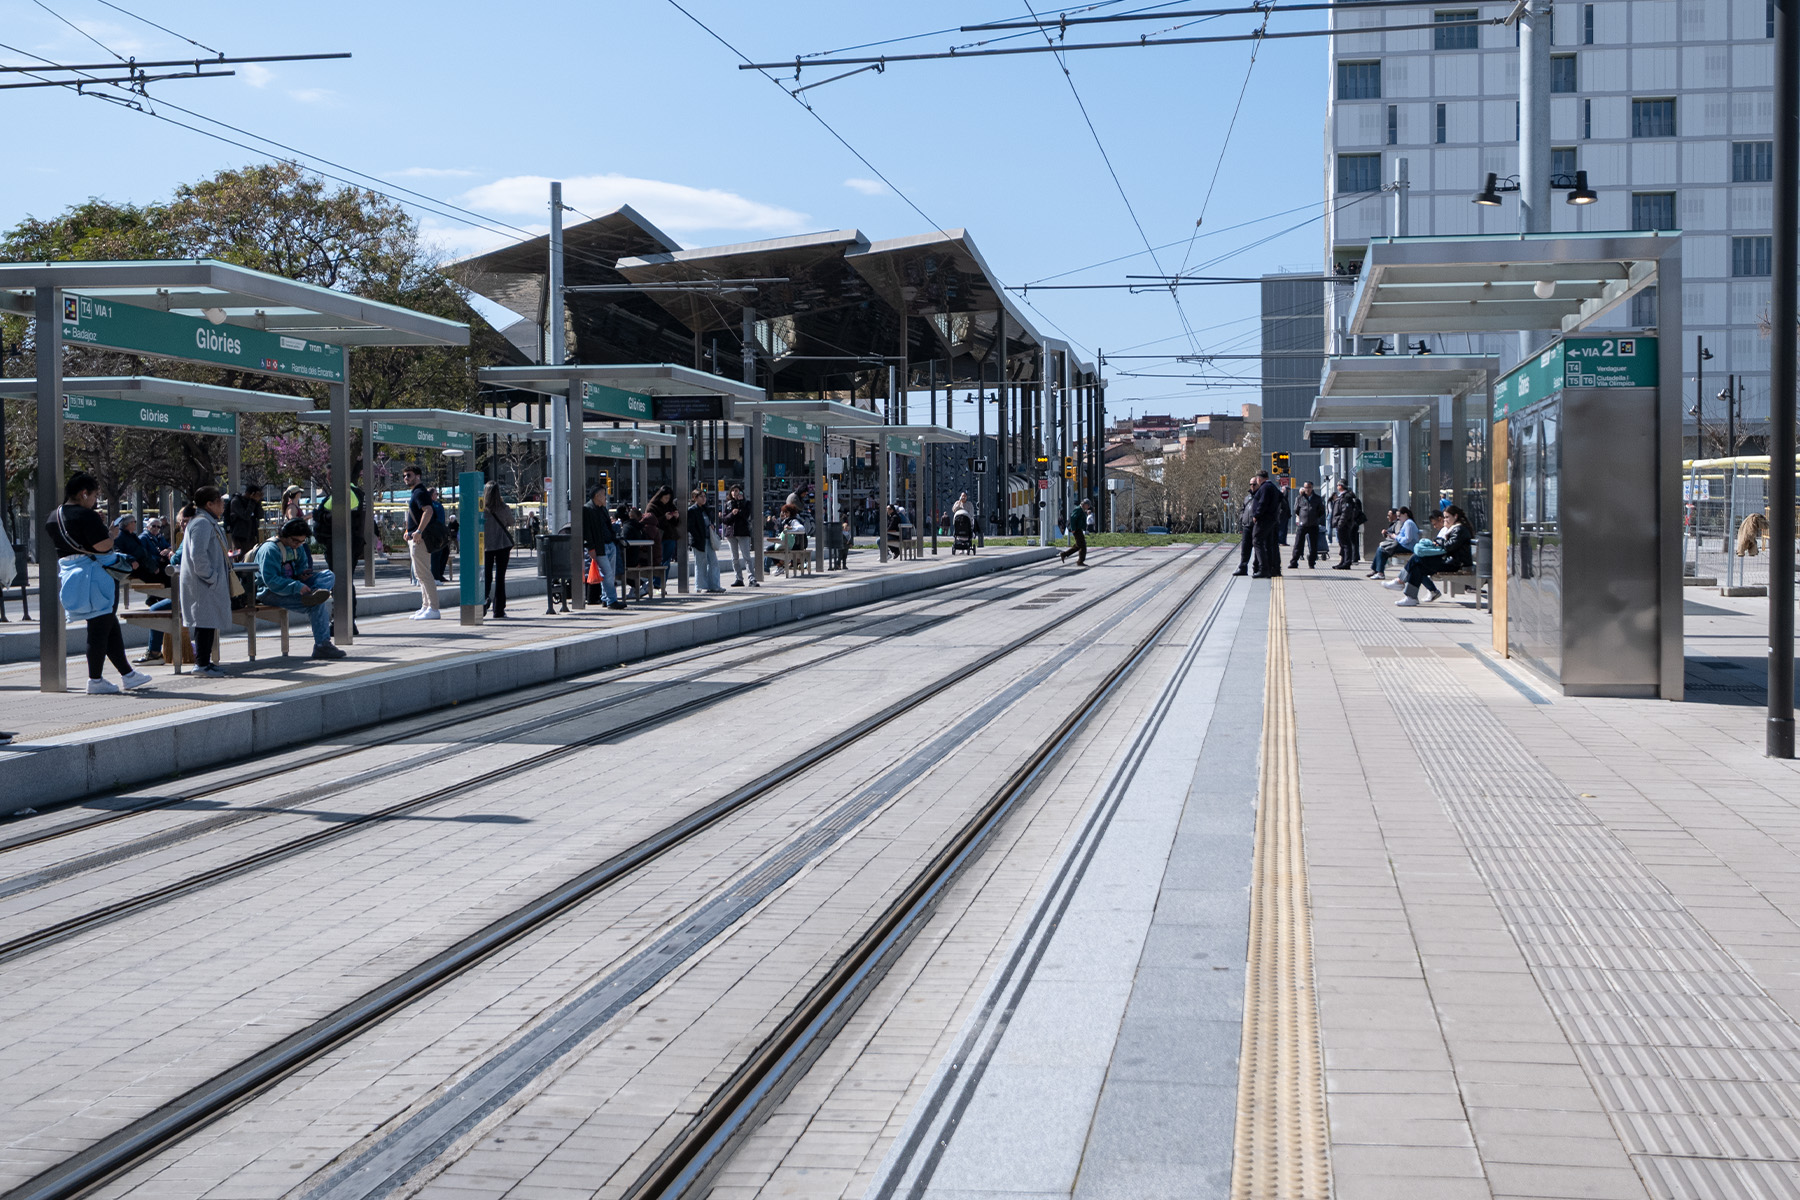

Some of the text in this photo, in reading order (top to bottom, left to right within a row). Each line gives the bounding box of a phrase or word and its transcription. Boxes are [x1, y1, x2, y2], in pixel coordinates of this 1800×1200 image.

[81, 300, 113, 318] T4 VIA 1
[72, 326, 97, 342] Badajoz
[195, 327, 241, 355] Glòries
[1581, 339, 1614, 357] VIA 2
[291, 362, 334, 378] Rambla dels Encants
[1568, 363, 1579, 372] T4
[1596, 365, 1627, 373] Verdaguer
[1568, 377, 1579, 385] T5
[1583, 376, 1593, 385] T6
[628, 396, 646, 413] Glòries
[140, 408, 169, 423] Glòries
[417, 430, 434, 442] Glòries
